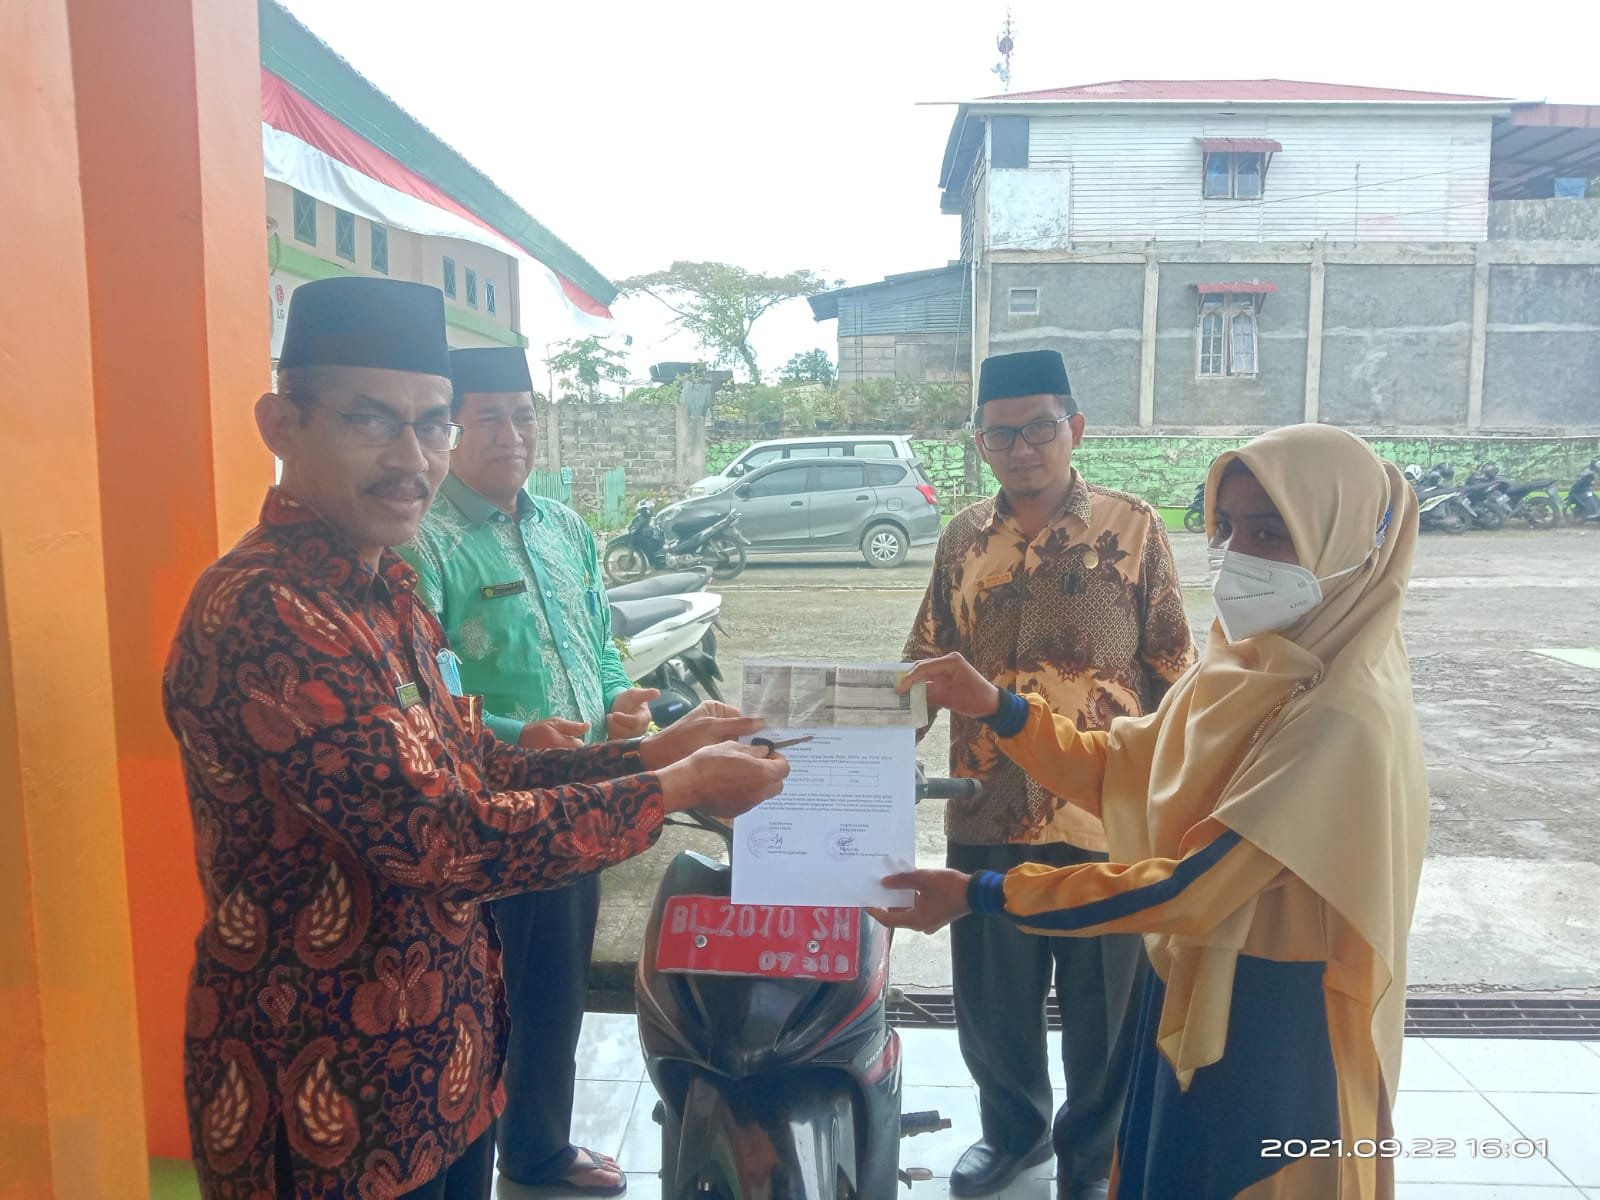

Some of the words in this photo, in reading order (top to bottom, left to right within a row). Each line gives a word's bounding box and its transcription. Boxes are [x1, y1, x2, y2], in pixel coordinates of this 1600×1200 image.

[276, 308, 285, 320] LG
[672, 904, 719, 936] BL
[720, 904, 799, 939] 2070
[758, 950, 795, 973] 07
